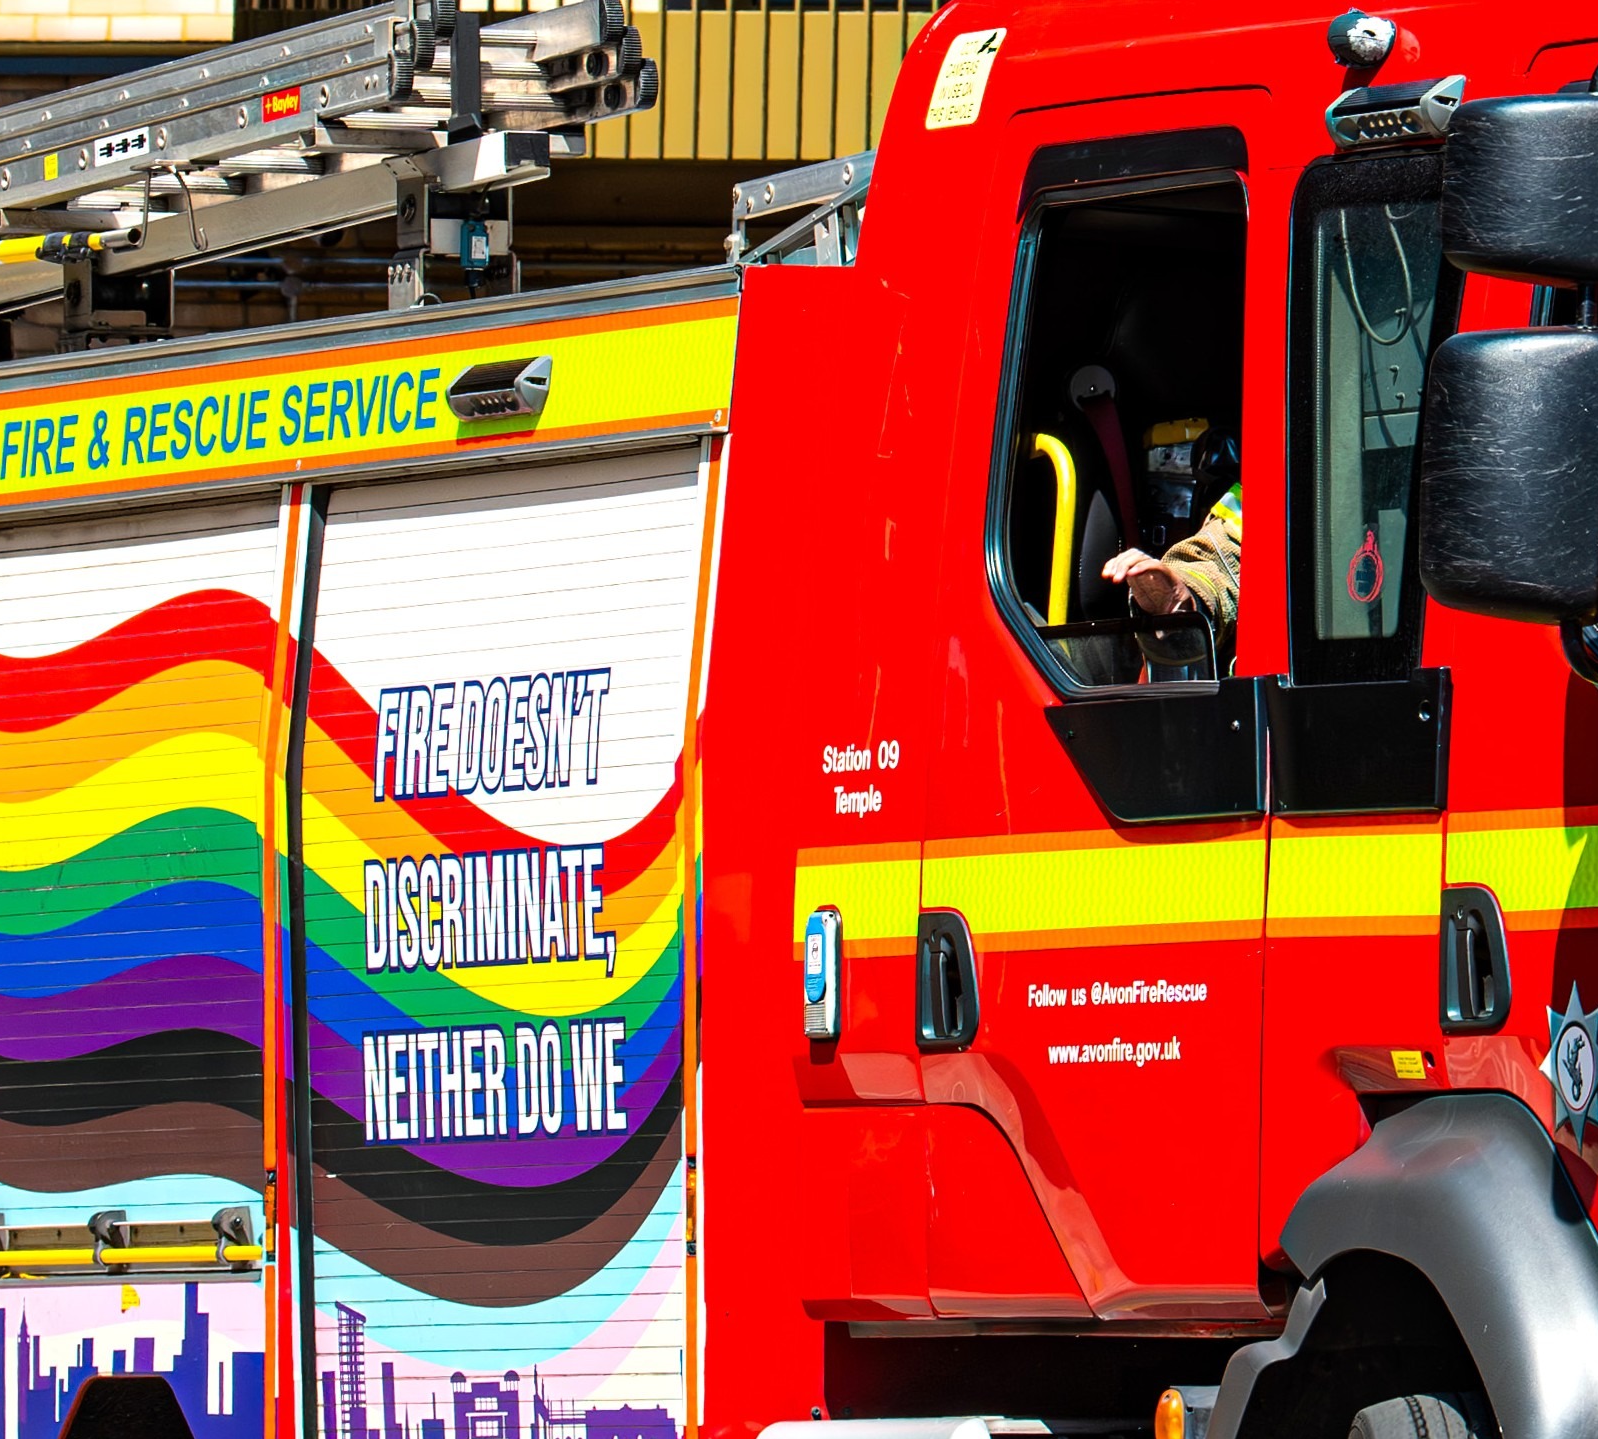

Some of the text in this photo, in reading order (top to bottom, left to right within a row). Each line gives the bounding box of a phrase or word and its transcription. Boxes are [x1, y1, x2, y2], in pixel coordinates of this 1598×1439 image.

[1, 415, 78, 480] FIRE
[88, 410, 110, 469] &
[121, 389, 270, 467] RESCUE
[280, 368, 441, 446] SERVICE
[374, 667, 611, 802] FIRE DOESN'T
[822, 740, 900, 774] Station 09
[834, 784, 882, 818] Temple
[364, 842, 616, 977] DISCRIMINATE,
[1028, 979, 1207, 1007] Follow us @AvonFireRescue
[362, 1016, 628, 1146] NEITHER DO WE
[1048, 1036, 1181, 1067] www.avonfire.gov.uk
